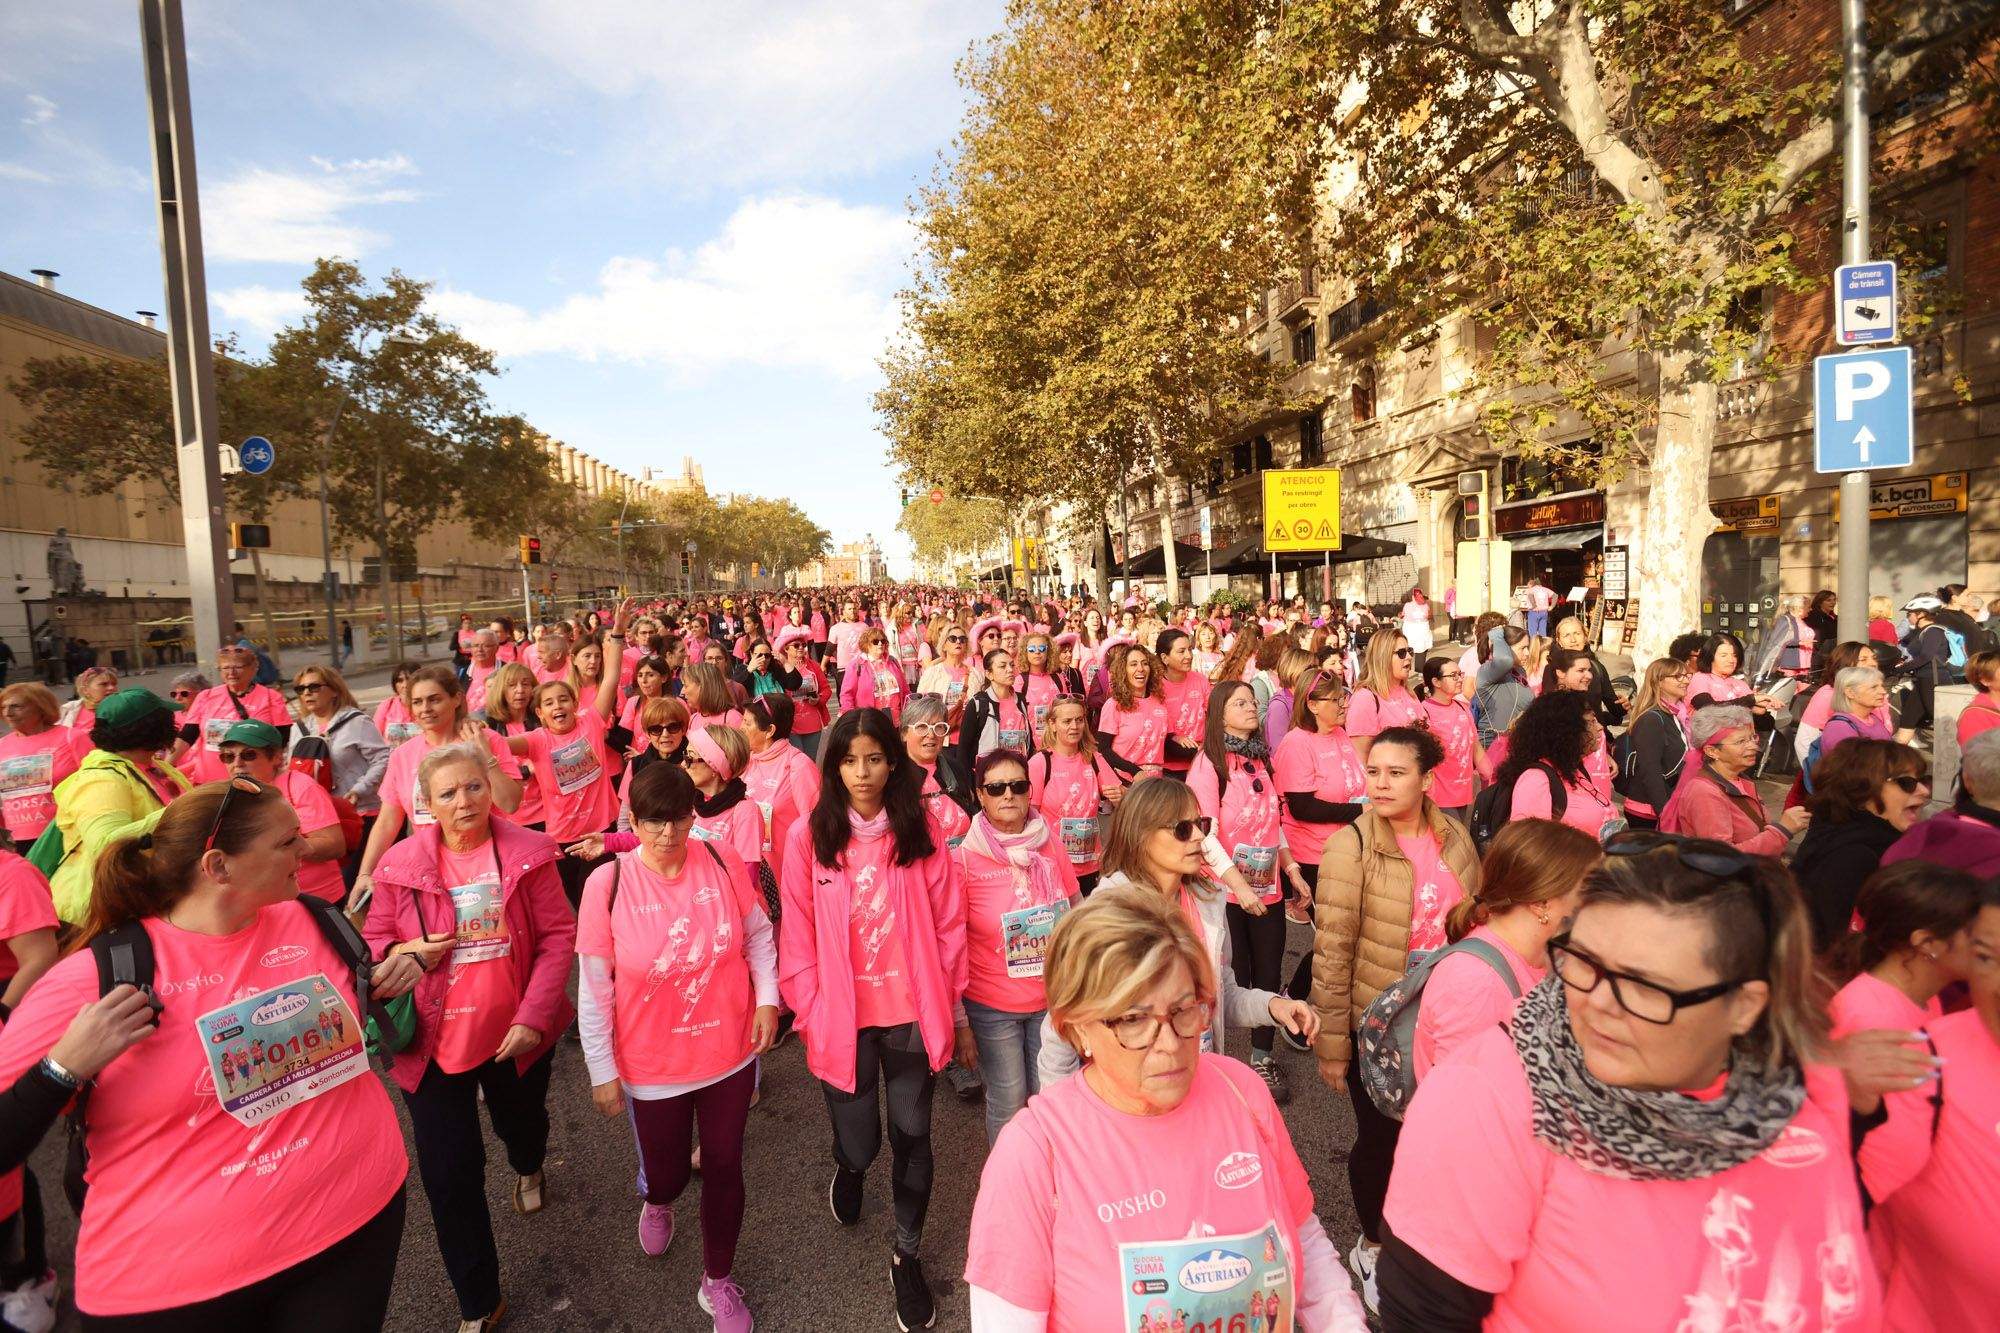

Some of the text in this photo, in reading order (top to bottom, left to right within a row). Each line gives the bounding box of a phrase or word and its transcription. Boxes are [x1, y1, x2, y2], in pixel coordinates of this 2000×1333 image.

[1835, 360, 1891, 422] P
[1902, 503, 1952, 512] AUTOESCOLA
[462, 918, 482, 932] 16
[1030, 935, 1046, 948] 01
[160, 974, 224, 996] OYSHO
[256, 998, 308, 1024] ASTURIANA
[268, 1028, 321, 1064] 016
[239, 1048, 354, 1104] CARRERA DE LA MUJER BARCELONA
[284, 1056, 310, 1074] 3734
[318, 1064, 356, 1086] Santander
[244, 1091, 291, 1120] OYSHO
[259, 1153, 270, 1164] DE
[272, 1149, 282, 1160] LA
[1098, 1189, 1166, 1223] OYSHO
[1134, 1262, 1165, 1275] SUMA
[1185, 1266, 1248, 1285] ASTURIANA
